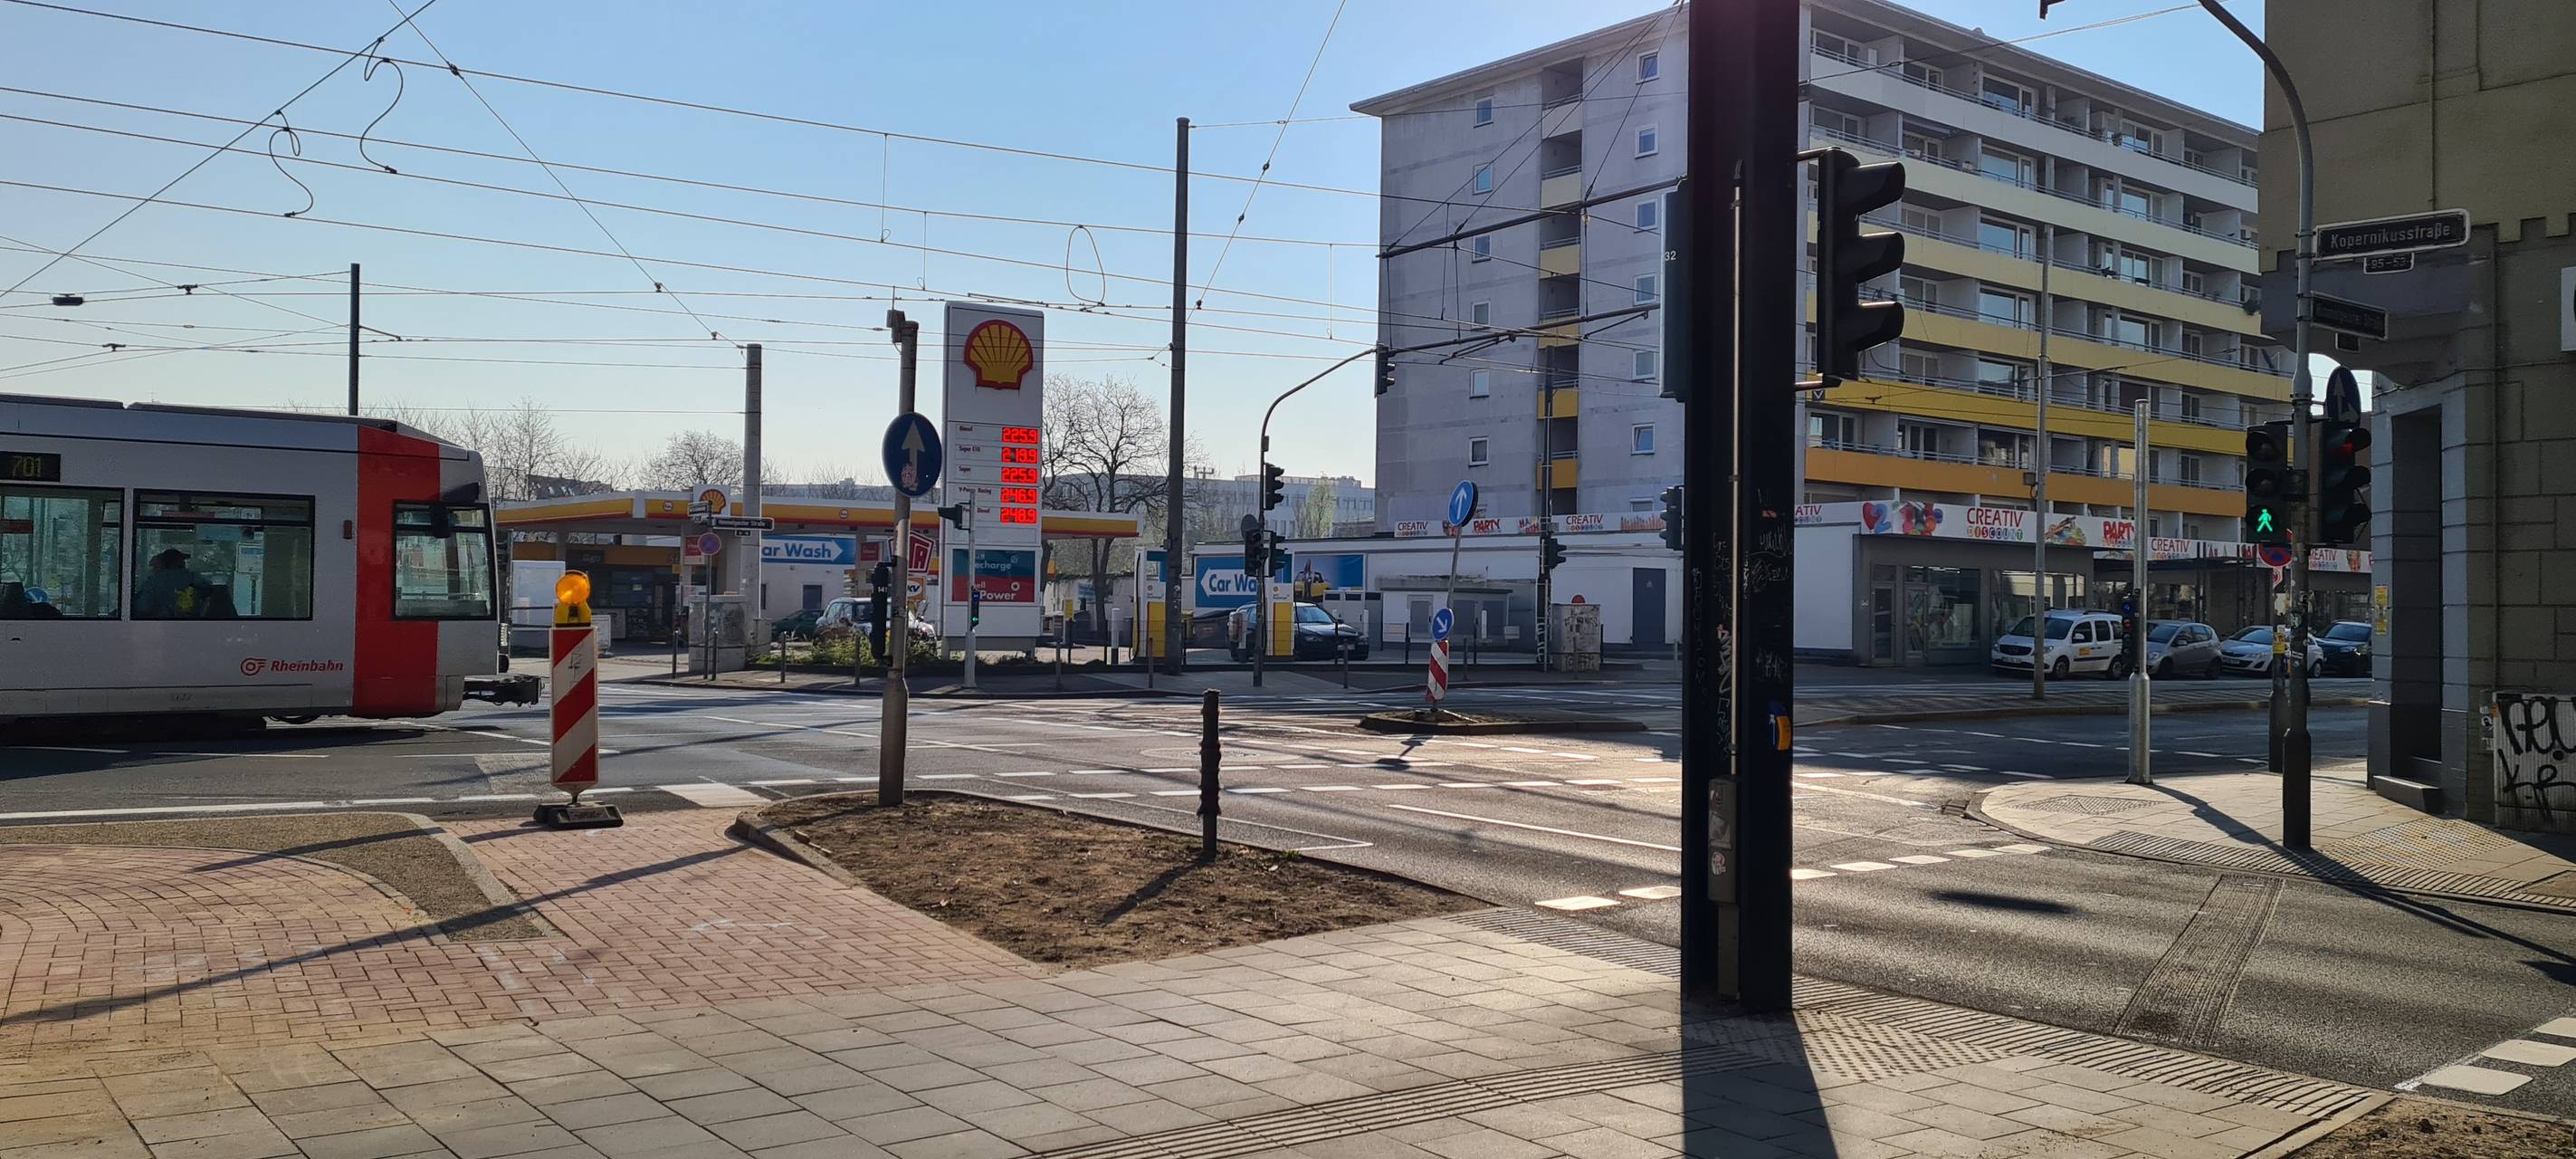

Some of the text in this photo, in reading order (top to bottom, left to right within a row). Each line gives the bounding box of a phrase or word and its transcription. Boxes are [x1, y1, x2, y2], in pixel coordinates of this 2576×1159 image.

[2331, 222, 2451, 249] Kopernikusstraße
[13, 455, 42, 478] 701
[1795, 505, 1822, 516] ATIV
[1566, 514, 1604, 524] CREATIV
[1967, 507, 2024, 527] CREATIV
[1398, 522, 1427, 531] CREATIV
[1474, 519, 1501, 532] PARTY
[762, 542, 832, 559] ar Wash
[2151, 539, 2190, 552] CREATIV
[2310, 550, 2336, 560] REATIV
[975, 560, 1012, 571] echarge
[1209, 574, 1258, 592] Car Wa
[979, 590, 1016, 600] Power
[271, 659, 344, 671] Rheinbahn
